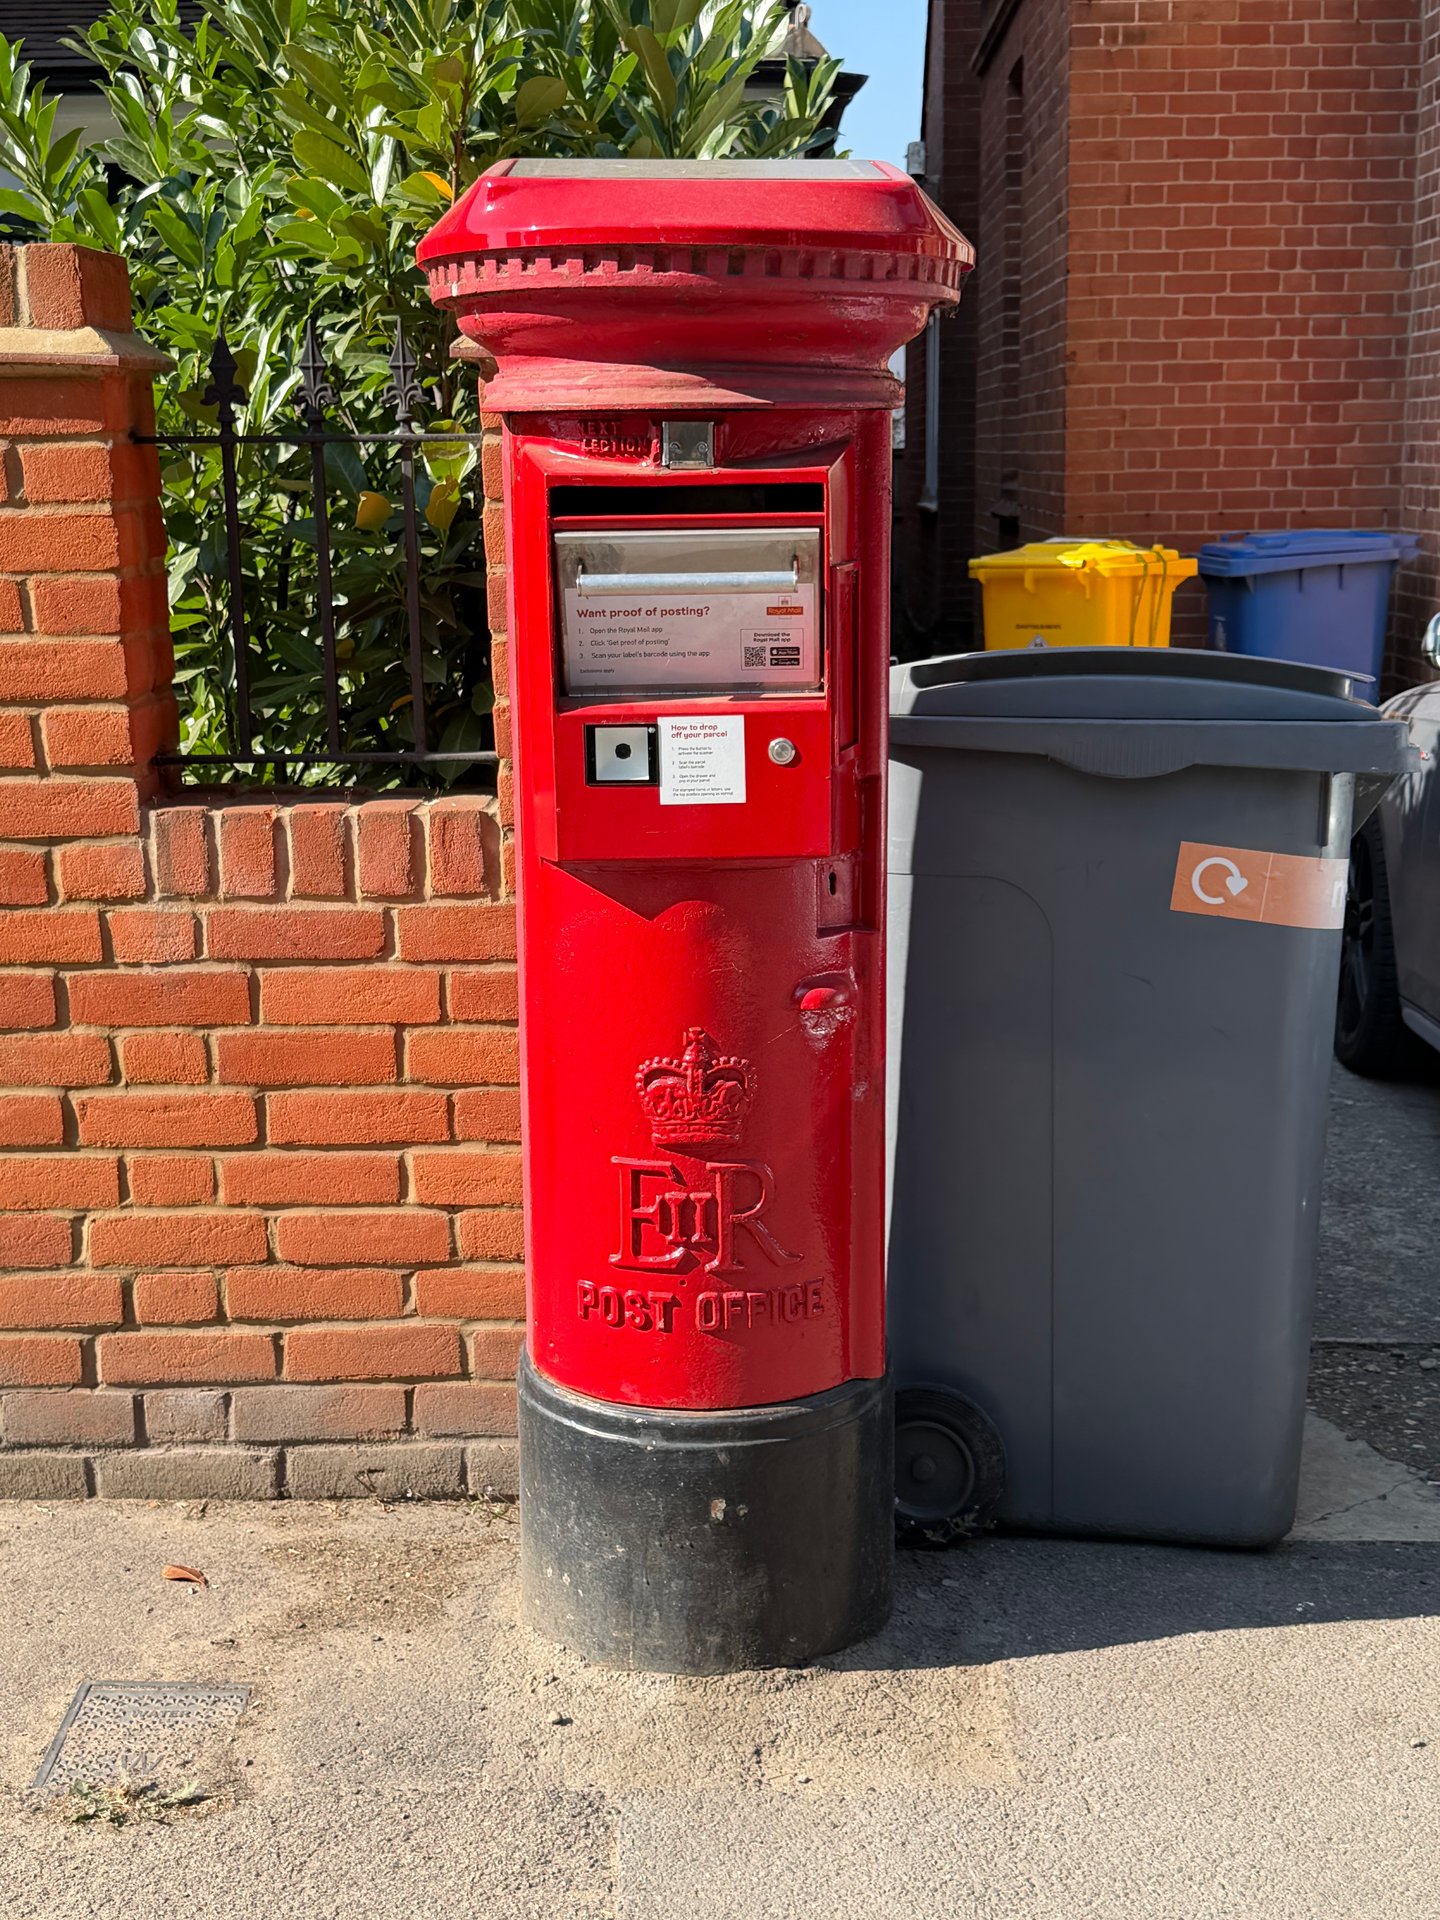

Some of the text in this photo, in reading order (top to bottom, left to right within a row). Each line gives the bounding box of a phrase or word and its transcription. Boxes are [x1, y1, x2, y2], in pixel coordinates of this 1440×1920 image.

[577, 421, 621, 436] NEXT
[576, 606, 710, 619] Want proof of posting?
[589, 627, 606, 635] Open
[618, 626, 636, 635] Royal
[651, 626, 663, 634] app
[620, 639, 637, 647] proof
[607, 652, 621, 660] your
[643, 650, 668, 658] barcode
[668, 651, 687, 659] using
[698, 650, 710, 658] app
[699, 723, 718, 732] drop
[671, 730, 728, 740] off your parcel
[576, 1277, 826, 1334] POST OFFICE
[132, 1709, 192, 1719] WATER
